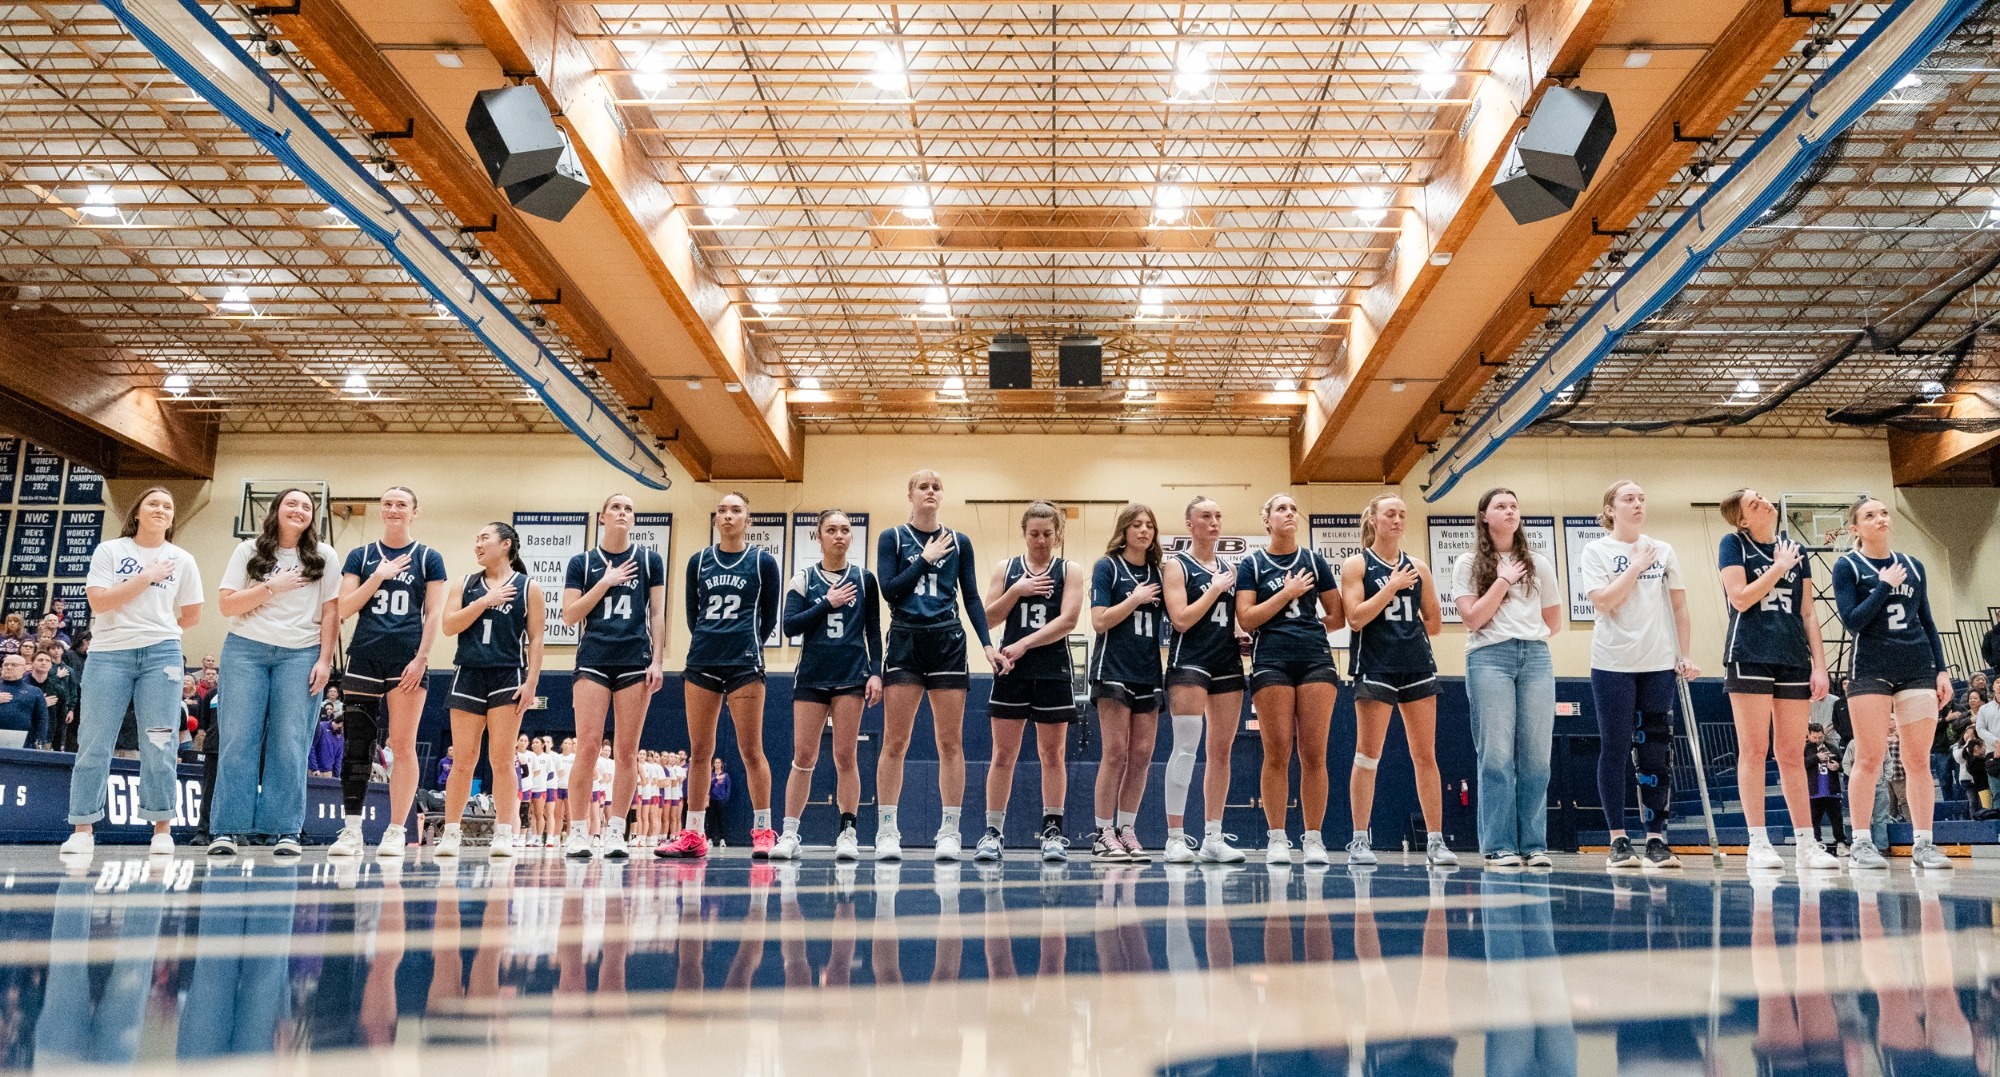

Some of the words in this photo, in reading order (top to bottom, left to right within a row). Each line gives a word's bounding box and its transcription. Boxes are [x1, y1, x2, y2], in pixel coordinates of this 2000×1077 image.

[25, 474, 60, 482] CHAMPIONS
[24, 513, 49, 523] NWC
[70, 513, 95, 523] NWC
[25, 529, 44, 537] MEN'S
[66, 529, 95, 537] WOMEN'S
[1441, 529, 1475, 538] Women's
[66, 538, 86, 546] TRACK
[527, 534, 572, 546] Baseball
[1438, 540, 1474, 549] Basketba
[12, 555, 48, 563] CHAMPIONS
[1318, 547, 1361, 559] ALL-SPO
[20, 563, 37, 571] 2023
[533, 560, 562, 573] NCAA
[704, 574, 747, 590] BRUINS
[61, 585, 86, 596] NWC
[371, 589, 410, 616] 30
[1760, 587, 1793, 614] 25
[603, 594, 632, 620] 14
[705, 594, 741, 620] 22
[1384, 595, 1413, 622] 21
[1020, 602, 1047, 629] 13
[1210, 601, 1229, 627] 4
[1886, 603, 1908, 630] 2
[544, 624, 576, 636] PIONS
[826, 612, 844, 639] 5
[1133, 610, 1153, 638] 11
[482, 618, 493, 644] 1
